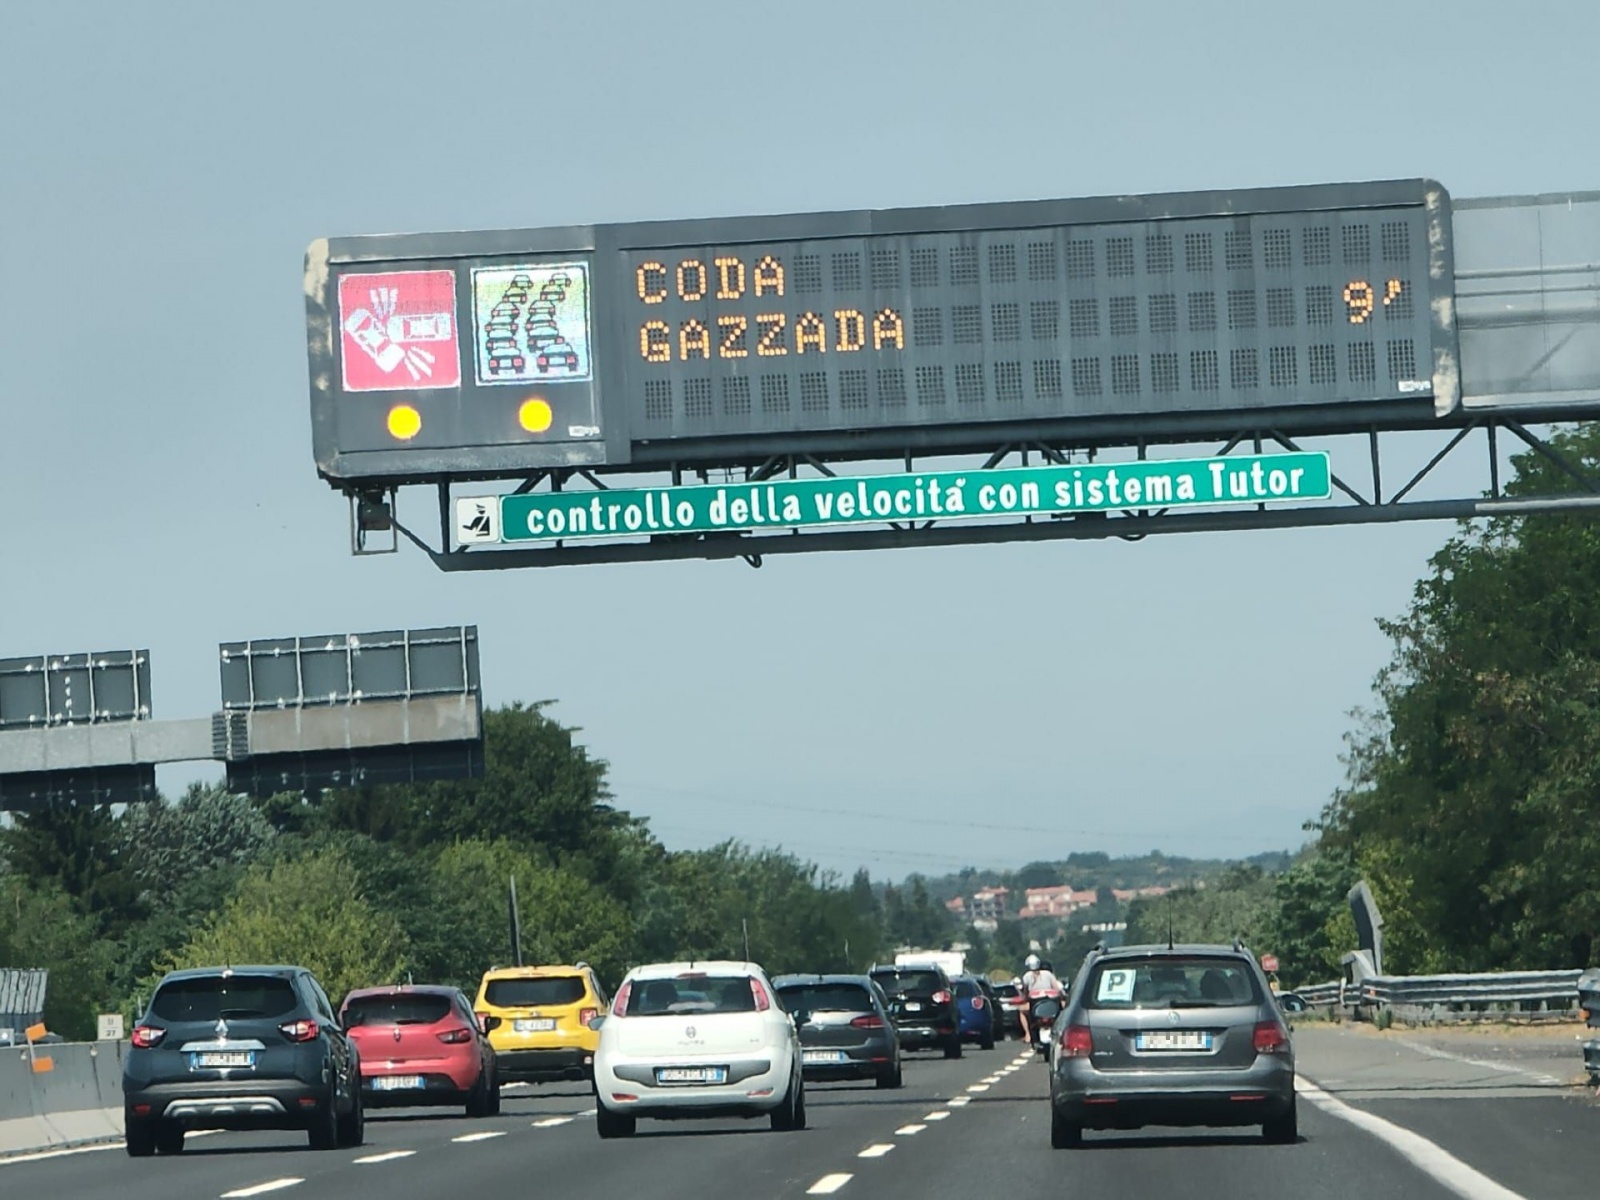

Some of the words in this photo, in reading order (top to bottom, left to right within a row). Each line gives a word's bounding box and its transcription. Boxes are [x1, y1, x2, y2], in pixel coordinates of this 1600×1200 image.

[637, 254, 784, 304] CODA
[639, 308, 904, 362] GAZZADA
[527, 492, 695, 535] controllo
[709, 486, 801, 526] della
[979, 481, 1039, 511] con
[1055, 469, 1196, 507] sistema
[1208, 461, 1305, 498] Tutor
[1107, 972, 1126, 991] P
